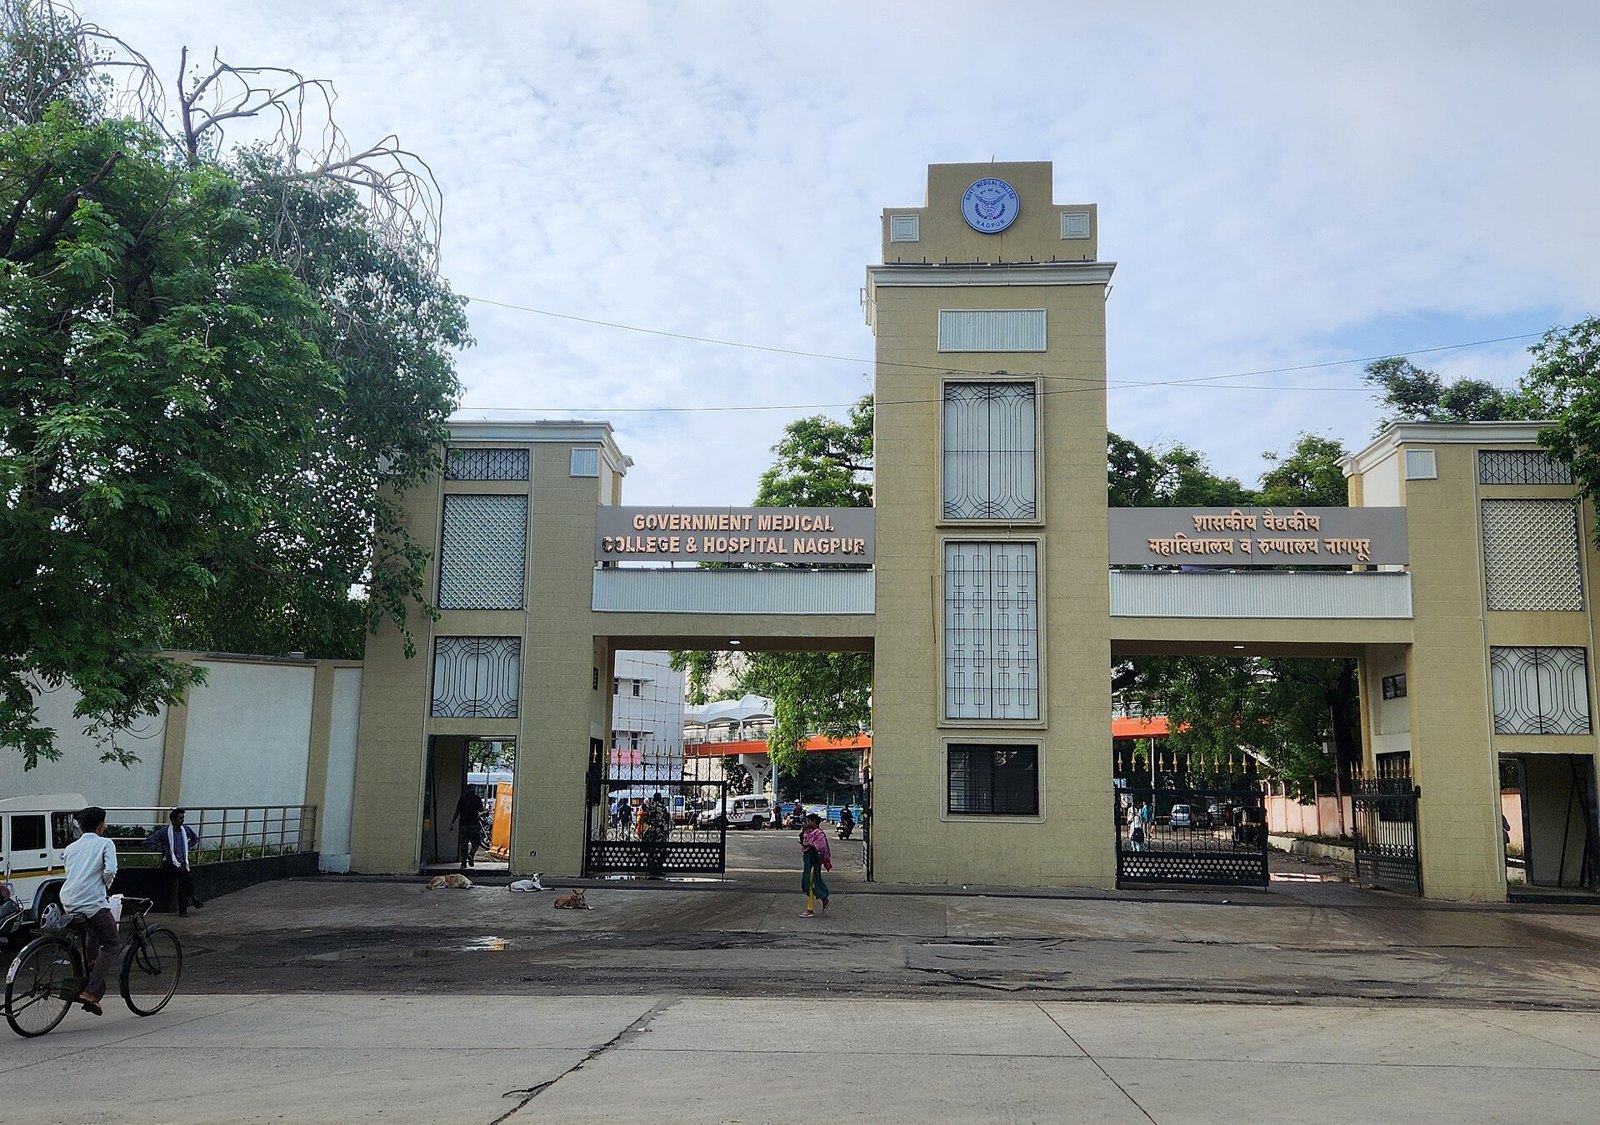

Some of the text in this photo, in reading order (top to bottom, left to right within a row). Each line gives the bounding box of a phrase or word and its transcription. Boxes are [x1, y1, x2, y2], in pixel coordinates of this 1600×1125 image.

[976, 180, 998, 188] MEDICAL
[999, 182, 1015, 199] COLLEGE
[976, 220, 1005, 228] NAGPUR
[632, 514, 834, 532] GOVERNMENT MEDICAL
[1192, 508, 1320, 532] शासकीय वैद्यकीय
[602, 536, 865, 555] COLLEGE & HOSPITAL NAGPUR
[1148, 531, 1234, 557] महाविद्यालय
[1239, 538, 1253, 555] व
[1324, 538, 1371, 561] नागपूर
